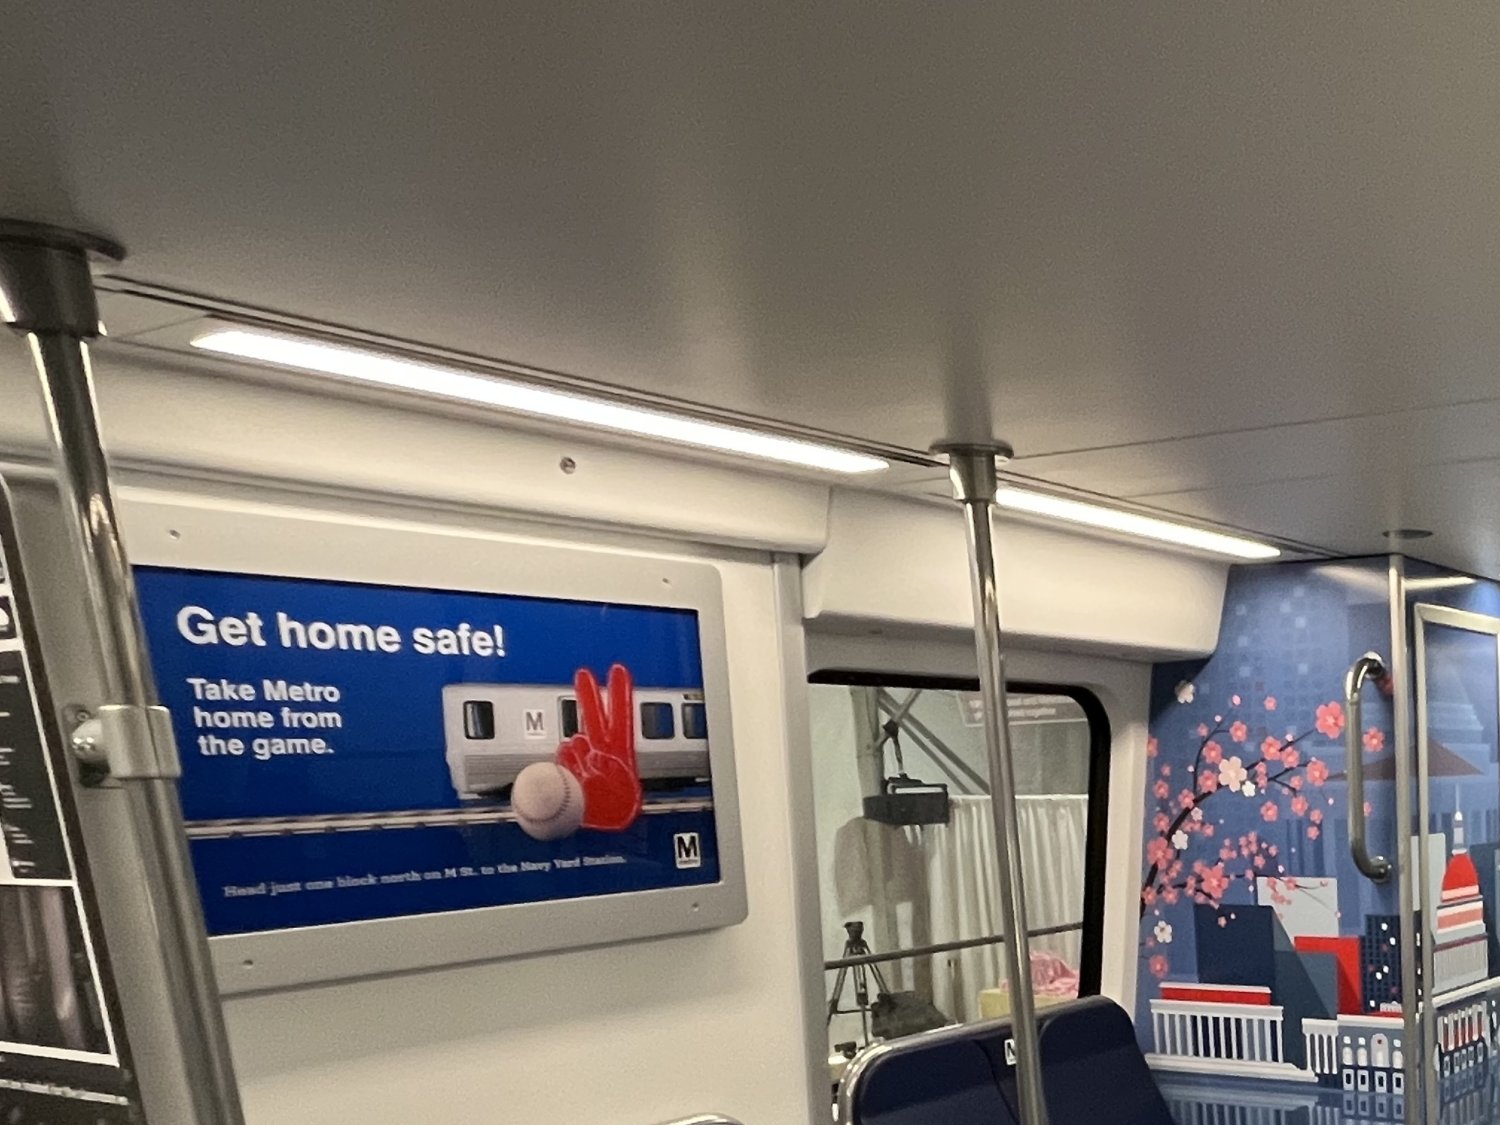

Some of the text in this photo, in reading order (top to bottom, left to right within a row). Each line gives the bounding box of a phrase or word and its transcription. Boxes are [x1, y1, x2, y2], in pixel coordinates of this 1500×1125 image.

[177, 606, 505, 657] Get home safe!
[186, 678, 340, 702] Take Metro
[193, 706, 342, 728] home from
[197, 735, 334, 760] the game.
[678, 836, 697, 858] M
[336, 874, 376, 888] block
[445, 869, 457, 878] M
[482, 866, 495, 874] to
[499, 863, 518, 874] the
[521, 861, 550, 873] Navy
